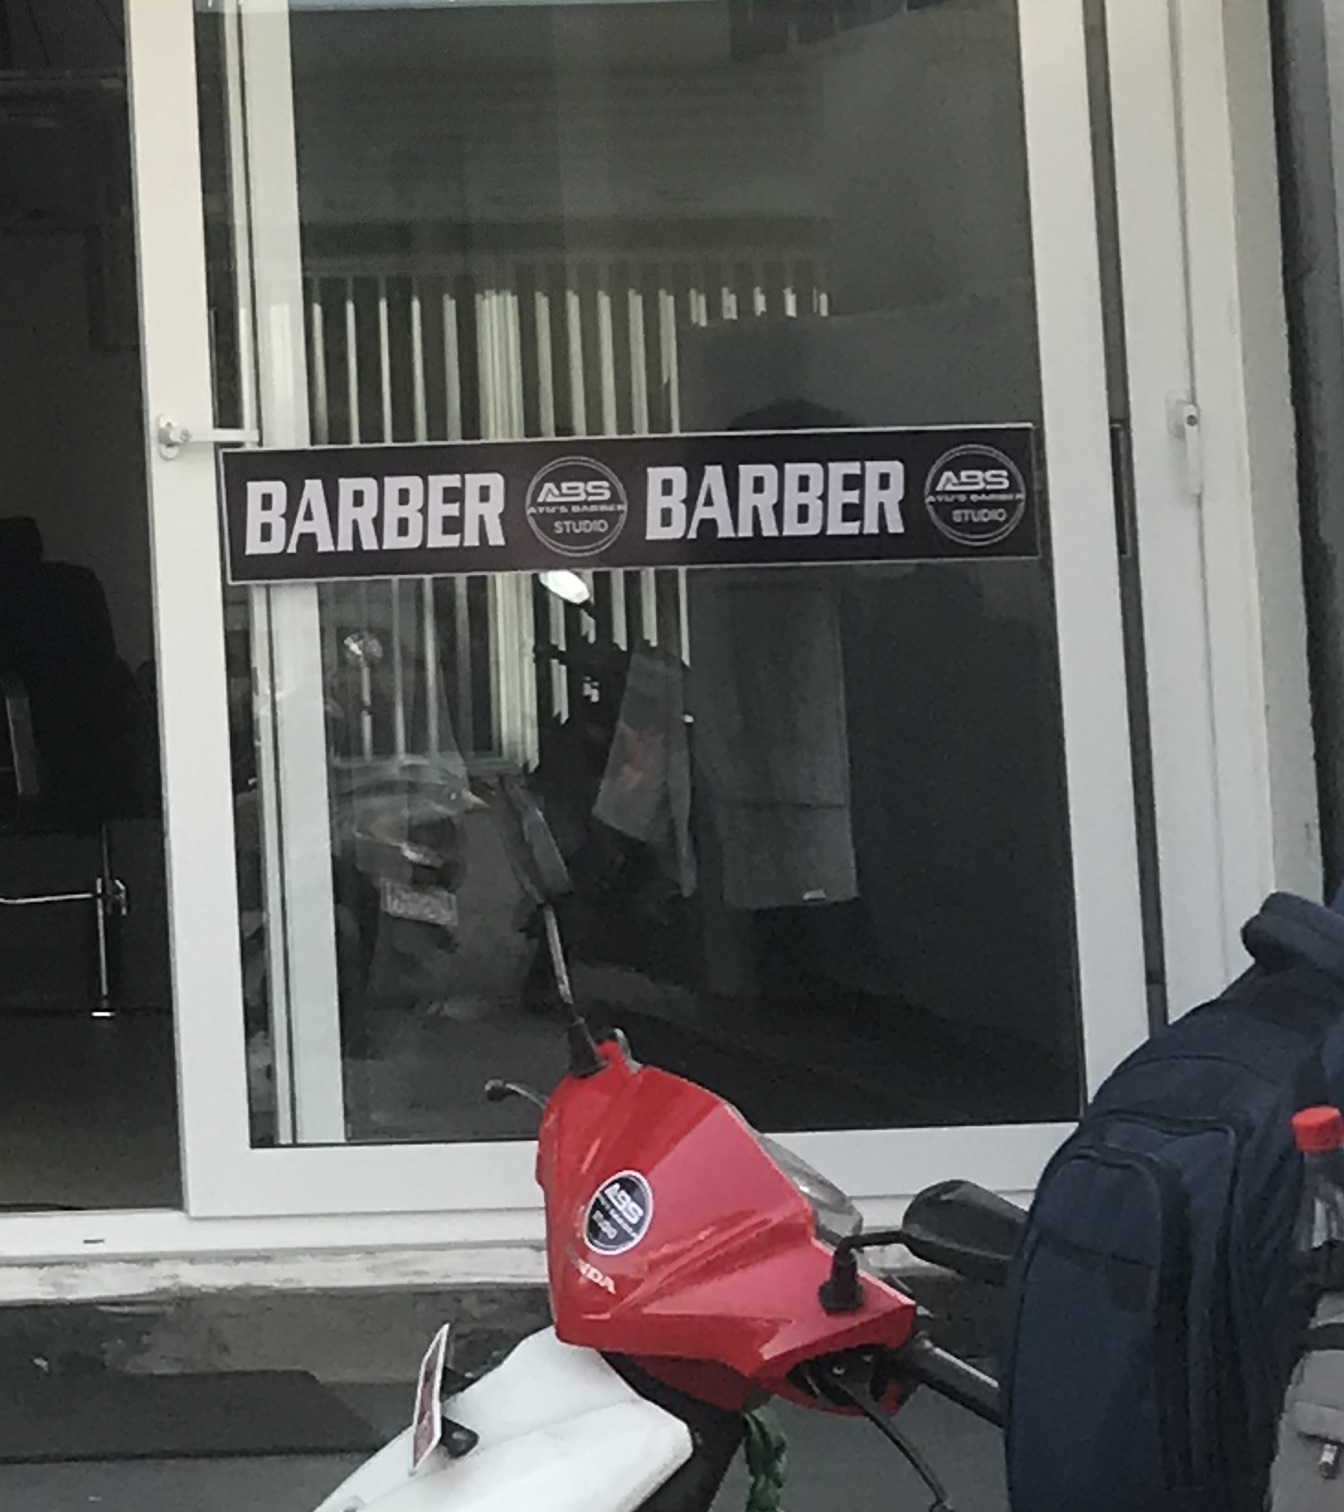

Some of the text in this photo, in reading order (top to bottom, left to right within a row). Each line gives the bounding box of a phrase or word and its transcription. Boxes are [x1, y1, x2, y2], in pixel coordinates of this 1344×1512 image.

[536, 480, 612, 503] ABS
[935, 469, 1010, 491] ABS
[644, 460, 905, 541] BARBER
[244, 472, 506, 556] BARBER
[553, 519, 609, 534] STUDIO
